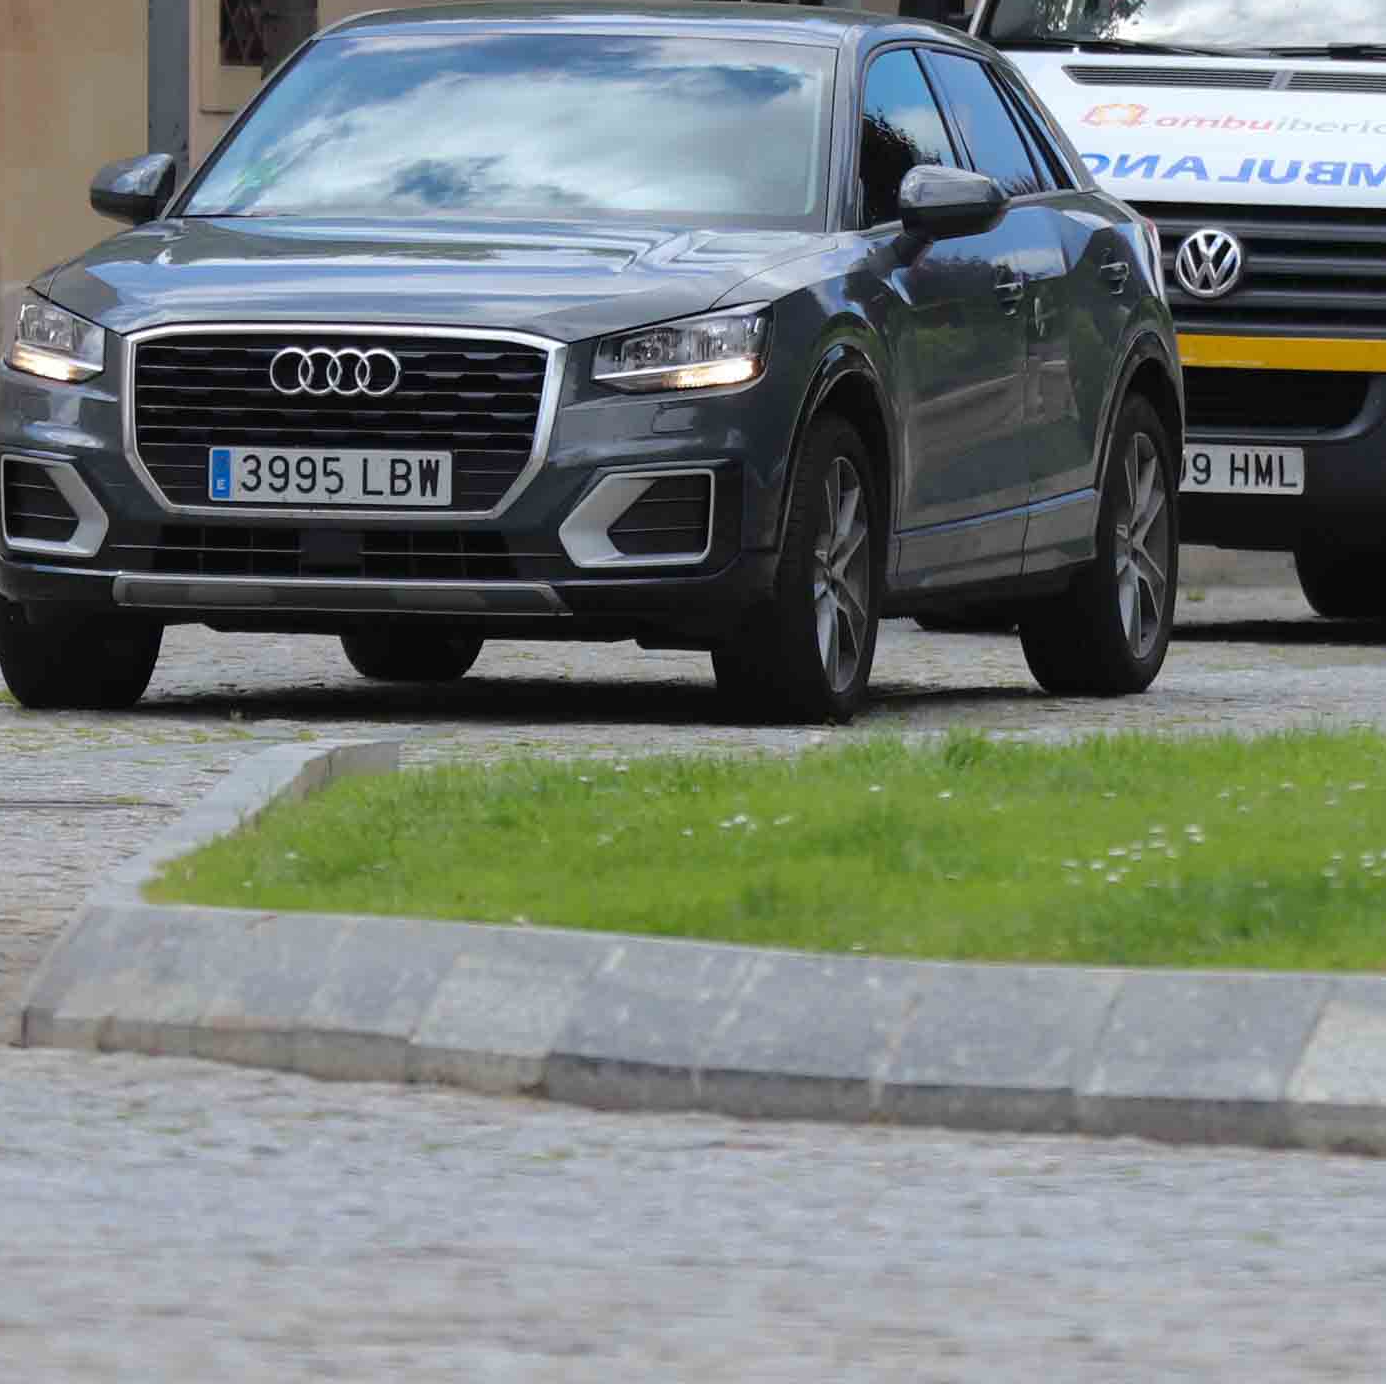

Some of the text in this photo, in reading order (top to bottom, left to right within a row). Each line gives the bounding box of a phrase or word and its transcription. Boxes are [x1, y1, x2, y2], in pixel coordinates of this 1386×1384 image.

[216, 479, 226, 491] E
[240, 454, 441, 498] 3995 LBW
[1181, 453, 1299, 489] 9 HML
